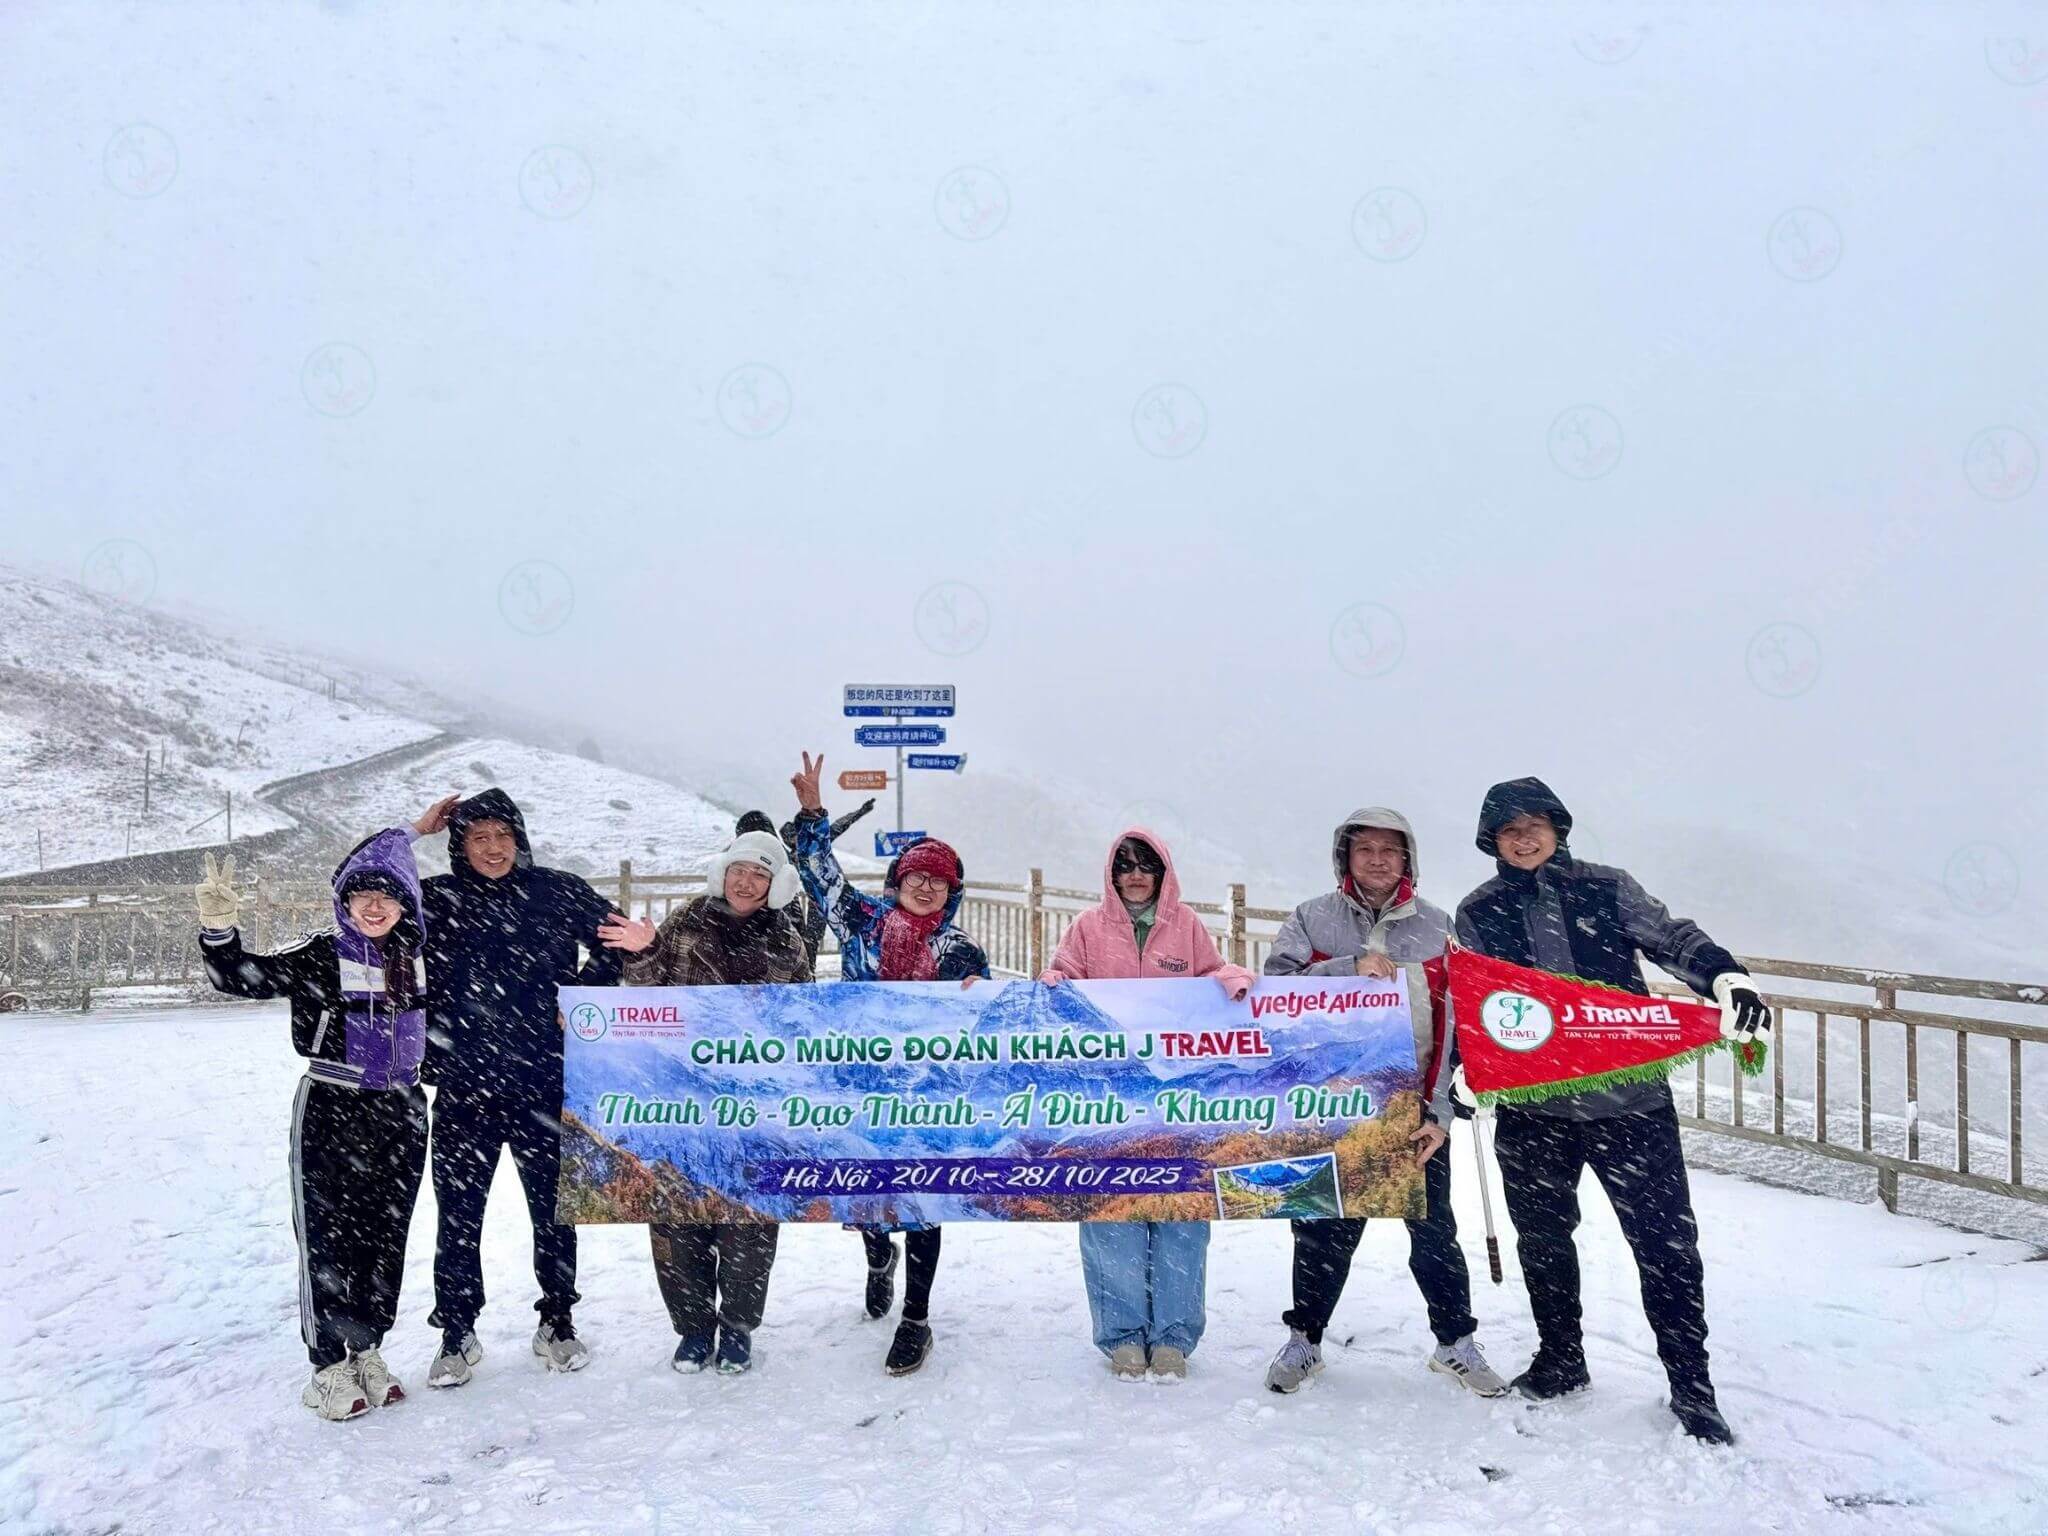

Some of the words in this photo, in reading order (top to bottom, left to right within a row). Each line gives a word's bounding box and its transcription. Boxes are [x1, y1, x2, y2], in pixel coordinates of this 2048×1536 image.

[1562, 1004, 1574, 1023] J
[1582, 1005, 1680, 1025] TRAVEL
[691, 1032, 785, 1065] CHÀO
[797, 1031, 892, 1063] MỪNG
[904, 1030, 998, 1062] ĐOÀN
[1011, 1028, 1125, 1060] KHÁCH
[1135, 1033, 1153, 1059] J
[1160, 1031, 1271, 1057] TRAVEL
[601, 1094, 705, 1126] Thành
[712, 1098, 758, 1128] Đô
[782, 1097, 854, 1133] Đạo
[862, 1094, 974, 1128] Thành
[1001, 1084, 1038, 1128] Á
[1041, 1090, 1129, 1126] Đinh
[1157, 1088, 1277, 1131] Khang
[1288, 1085, 1376, 1127] Định
[781, 1167, 820, 1187] Hà
